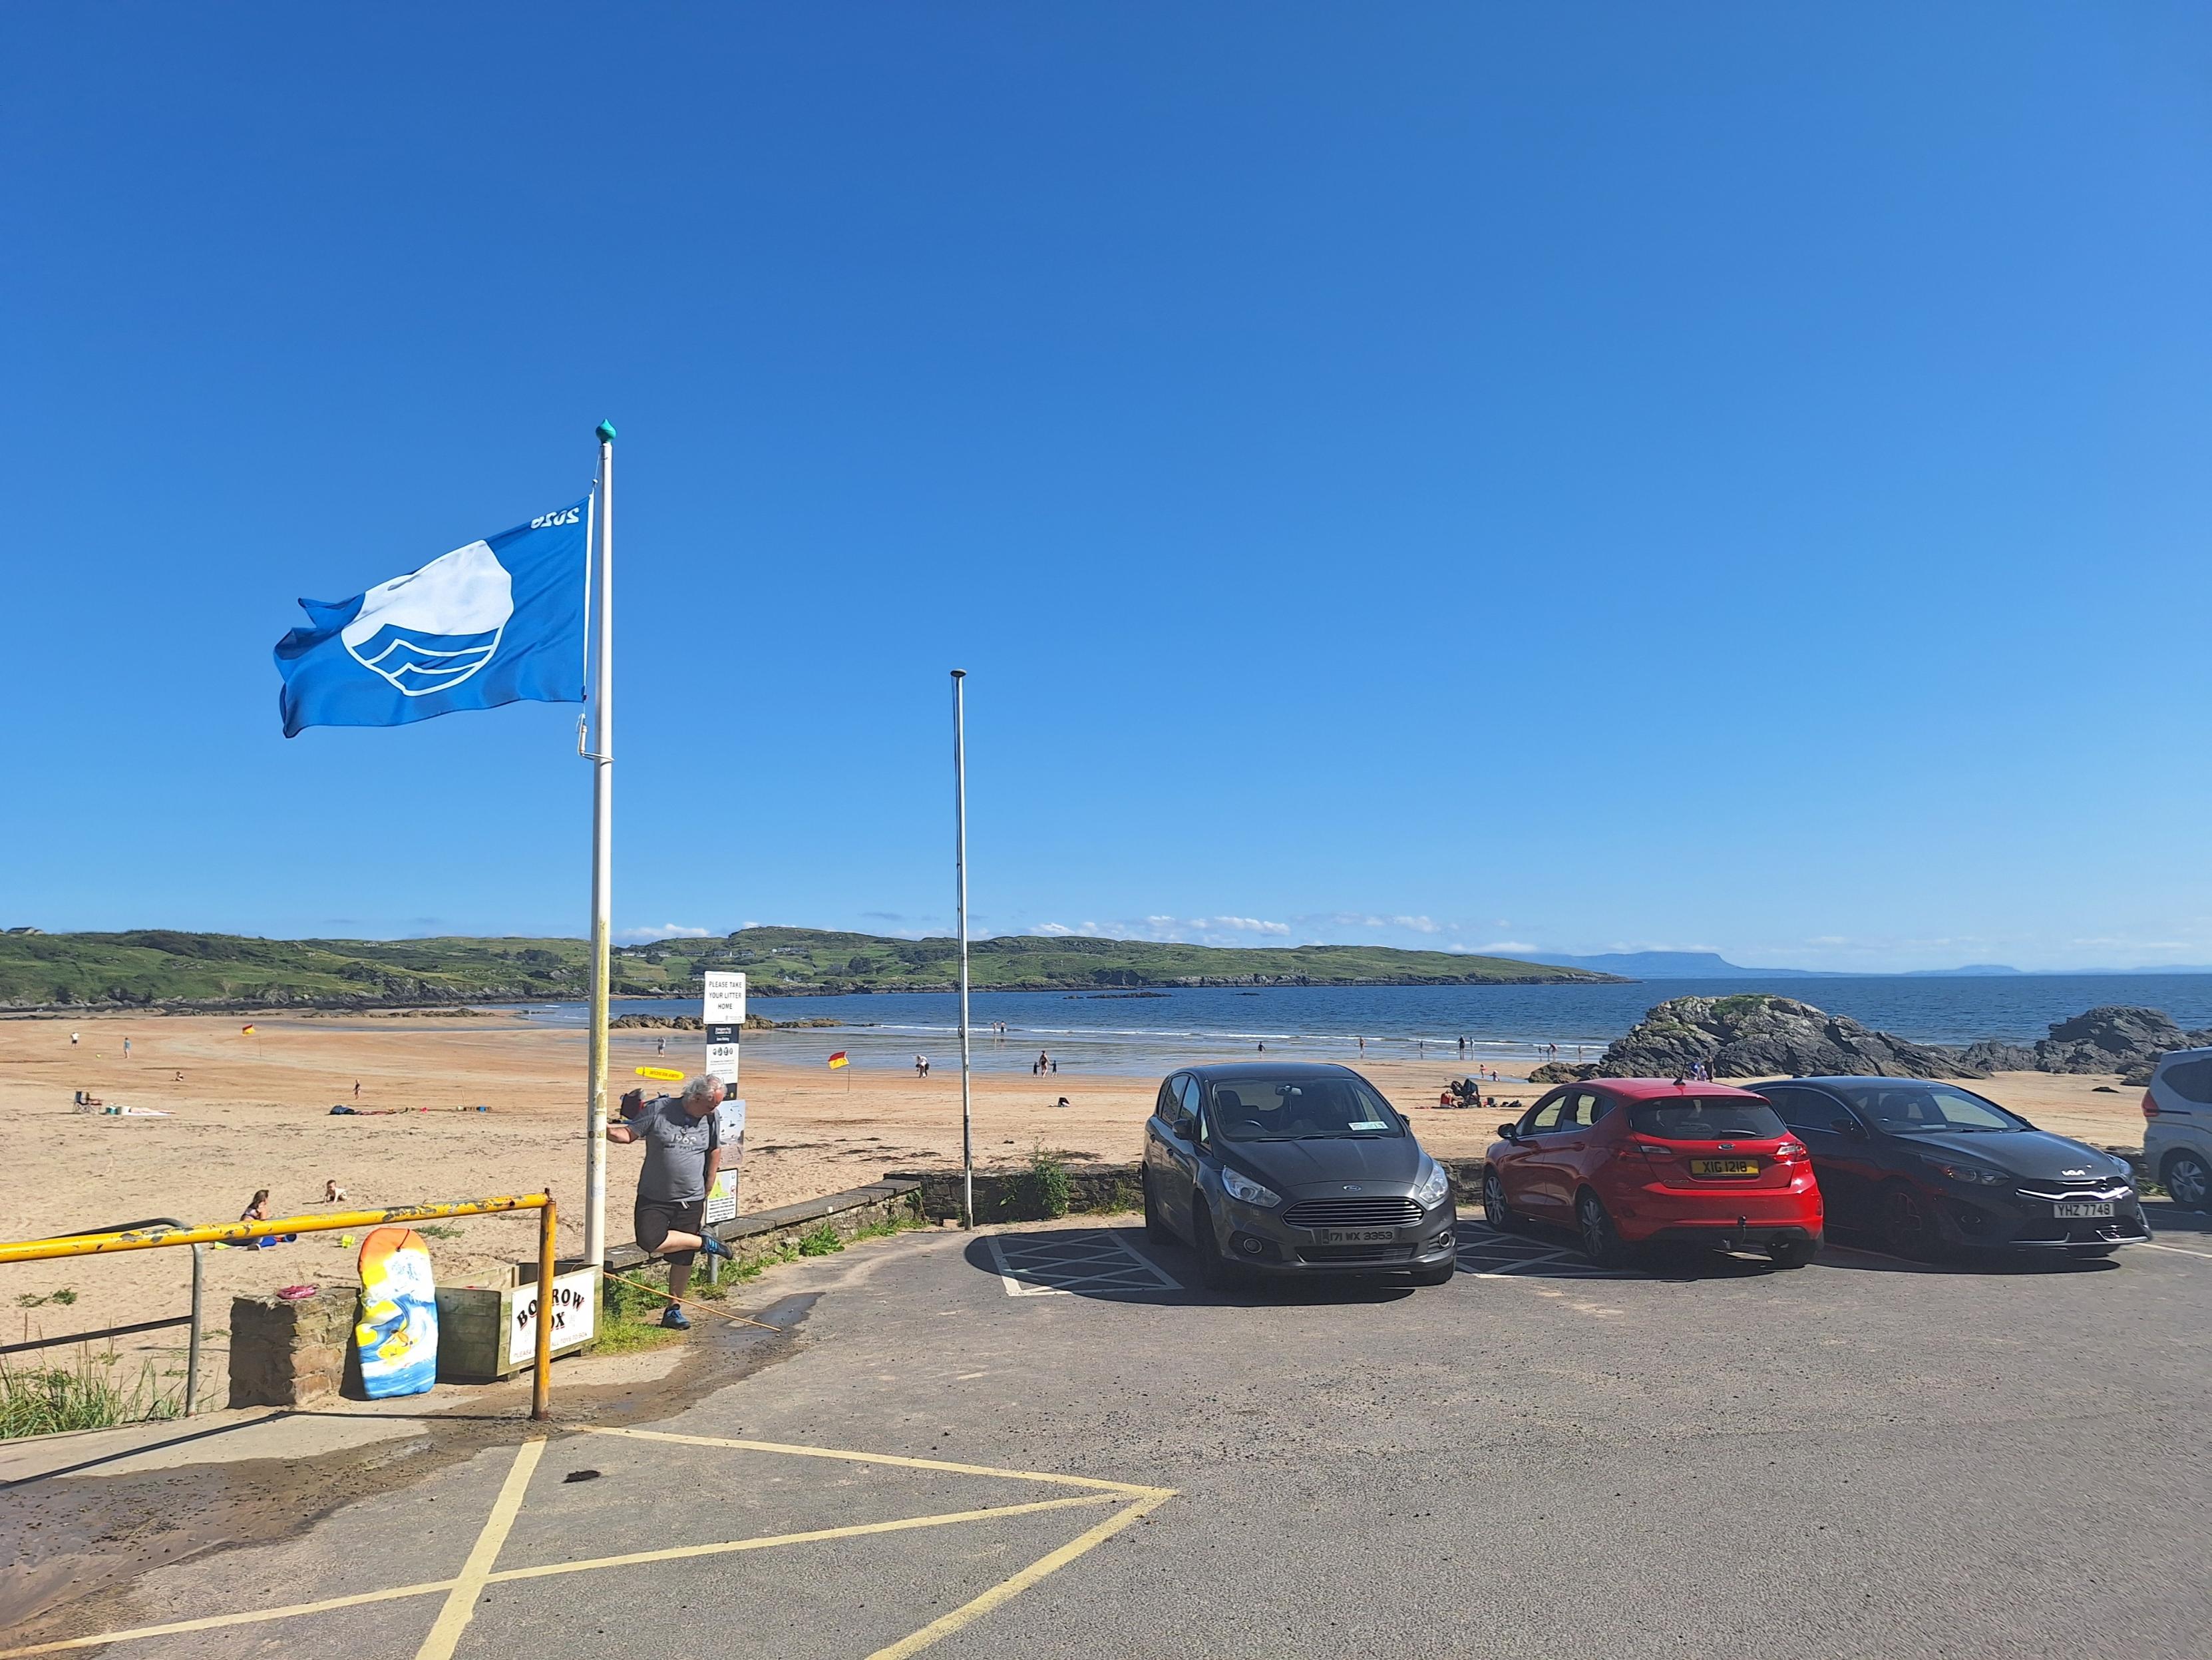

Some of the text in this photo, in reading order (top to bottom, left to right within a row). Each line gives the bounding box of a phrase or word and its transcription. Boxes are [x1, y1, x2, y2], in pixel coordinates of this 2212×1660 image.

[1702, 1161, 1747, 1173] XIG 1218
[2058, 1203, 2110, 1216] YHZ 7748
[1330, 1232, 1342, 1241] 171
[1346, 1232, 1361, 1241] WX
[516, 1289, 585, 1331] BOROW
